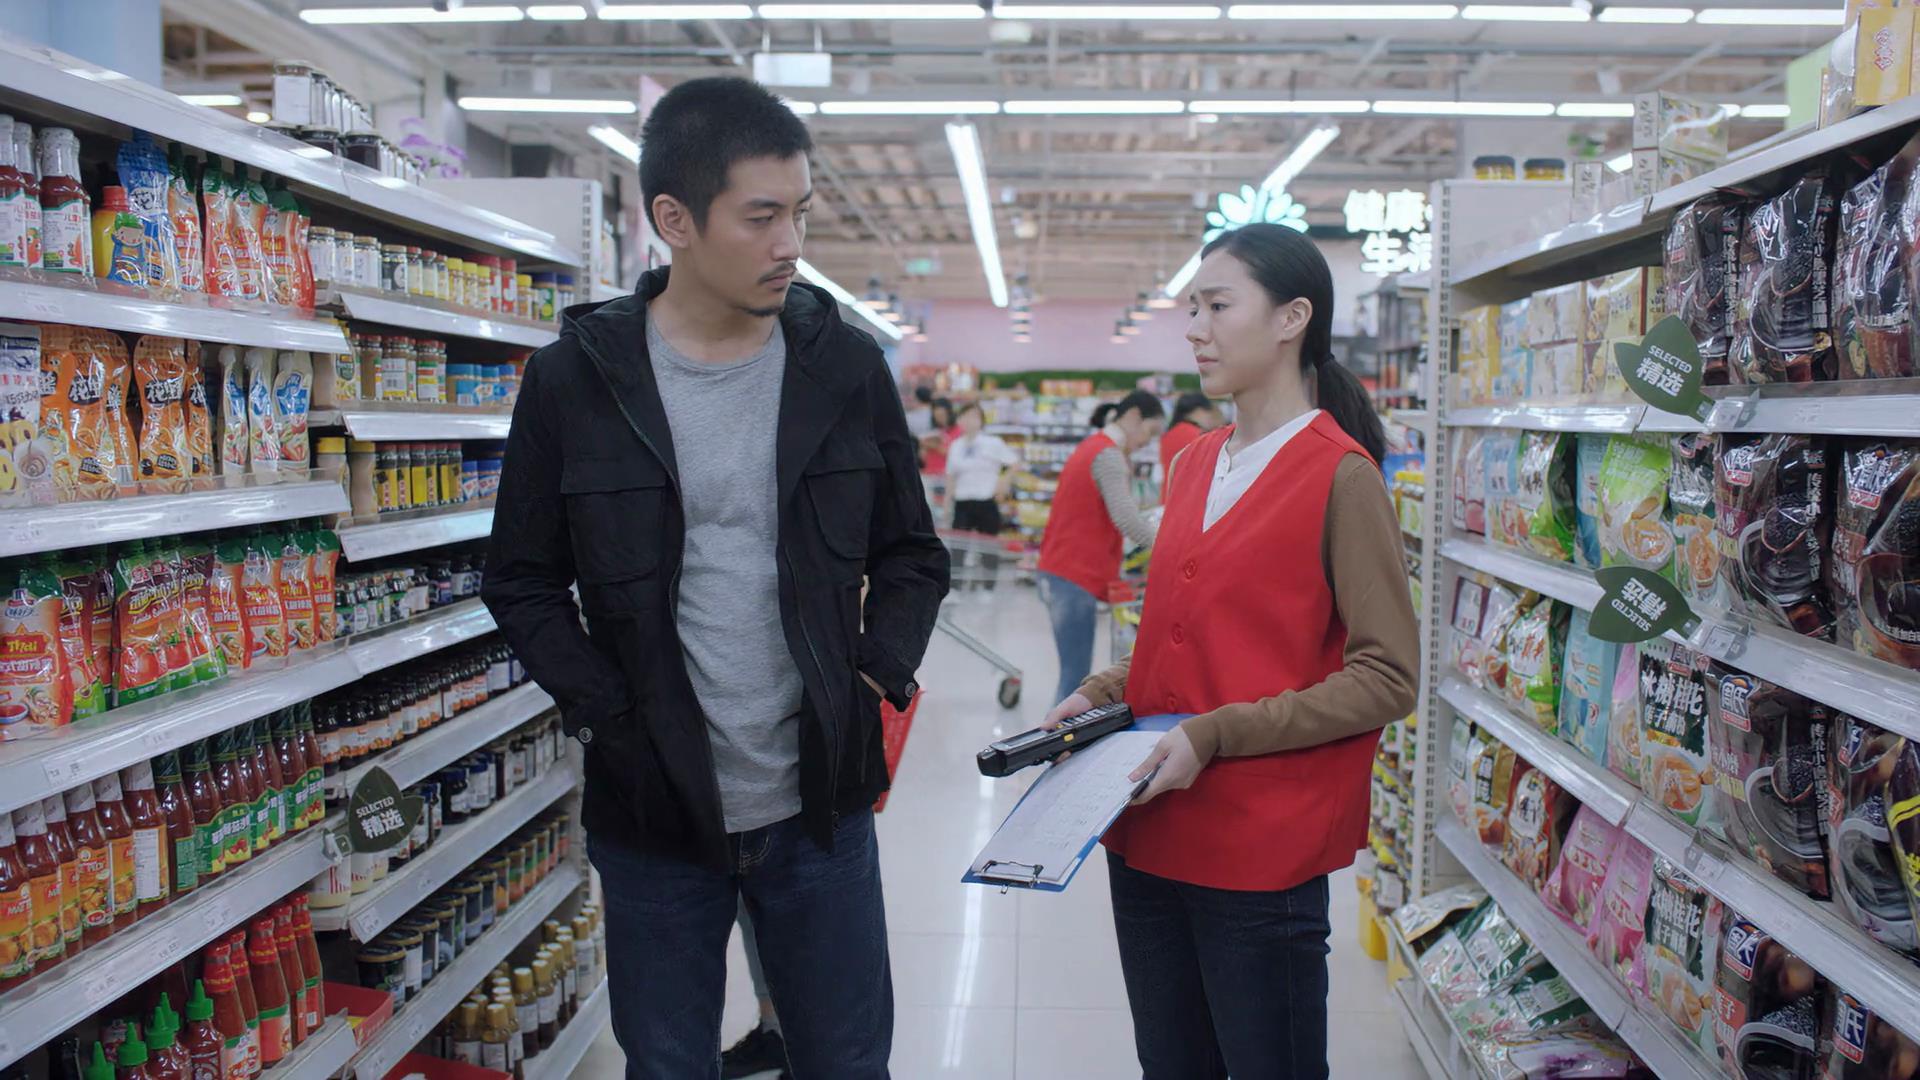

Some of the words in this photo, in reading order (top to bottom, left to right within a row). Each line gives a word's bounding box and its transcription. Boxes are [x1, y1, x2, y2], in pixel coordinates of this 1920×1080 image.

[1647, 344, 1693, 374] SELECTED
[1635, 356, 1684, 397] 精选
[1611, 598, 1652, 632] SELECTED
[1620, 577, 1668, 621] 精选
[7, 640, 38, 652] Thai
[356, 796, 394, 818] SELECTED
[361, 808, 405, 840] 精选
